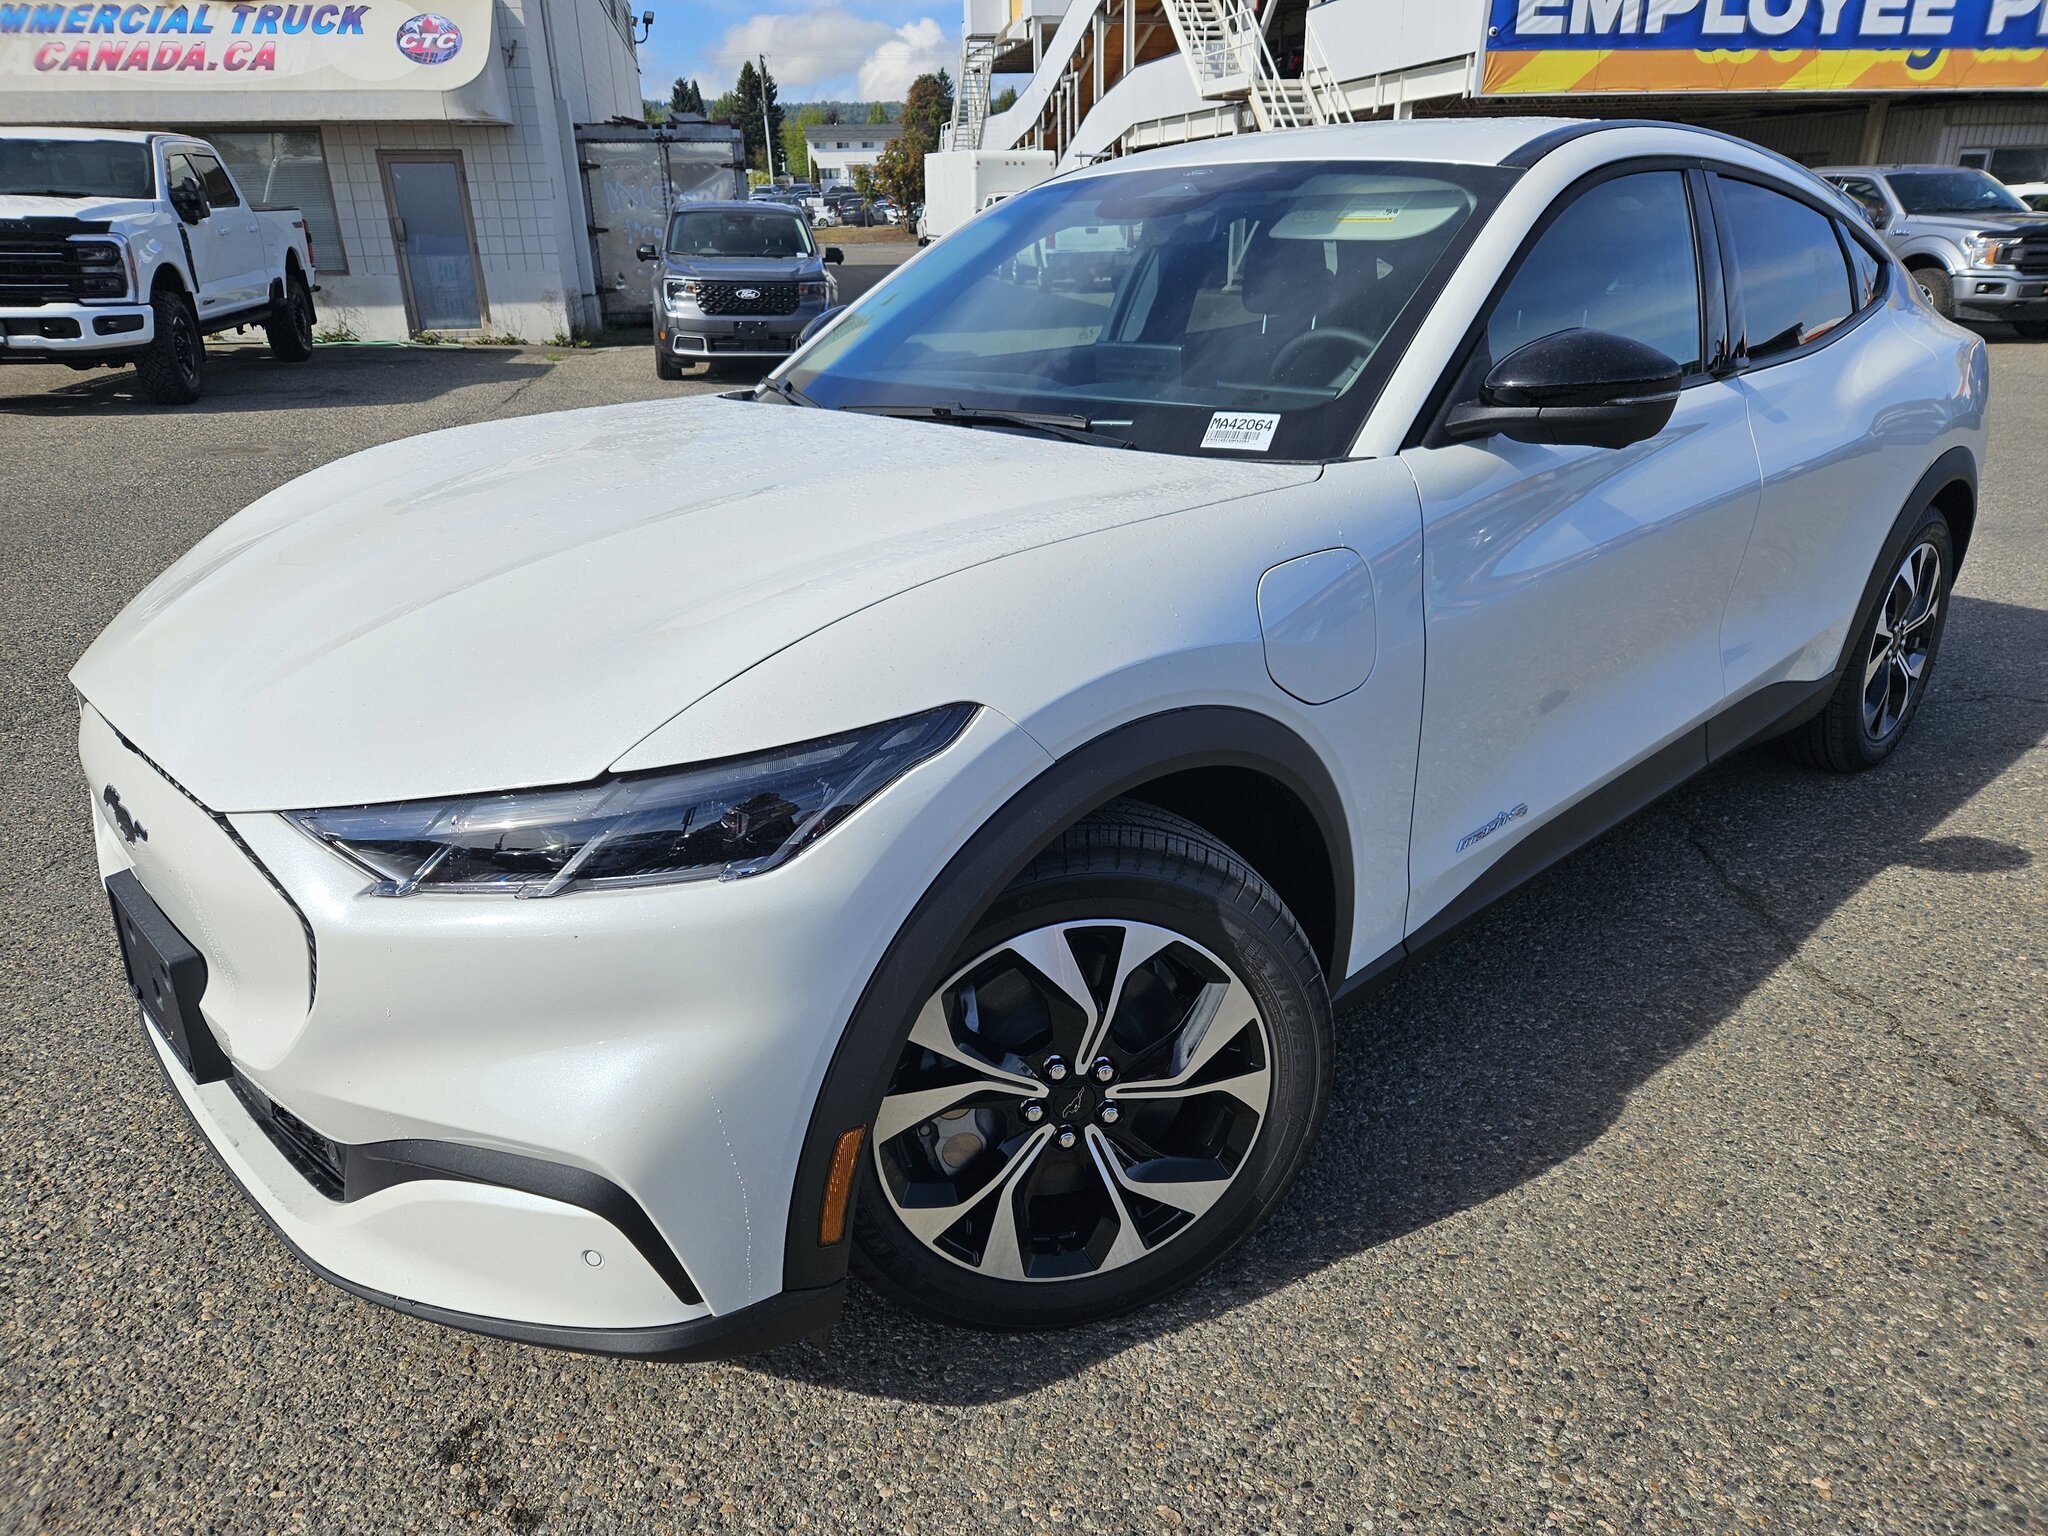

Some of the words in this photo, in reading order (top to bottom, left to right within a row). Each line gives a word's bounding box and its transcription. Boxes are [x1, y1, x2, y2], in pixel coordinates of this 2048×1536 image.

[231, 5, 372, 35] TRUCK
[400, 33, 457, 49] CTC
[34, 41, 276, 71] CANADA.CA
[1209, 417, 1274, 432] MA42064
